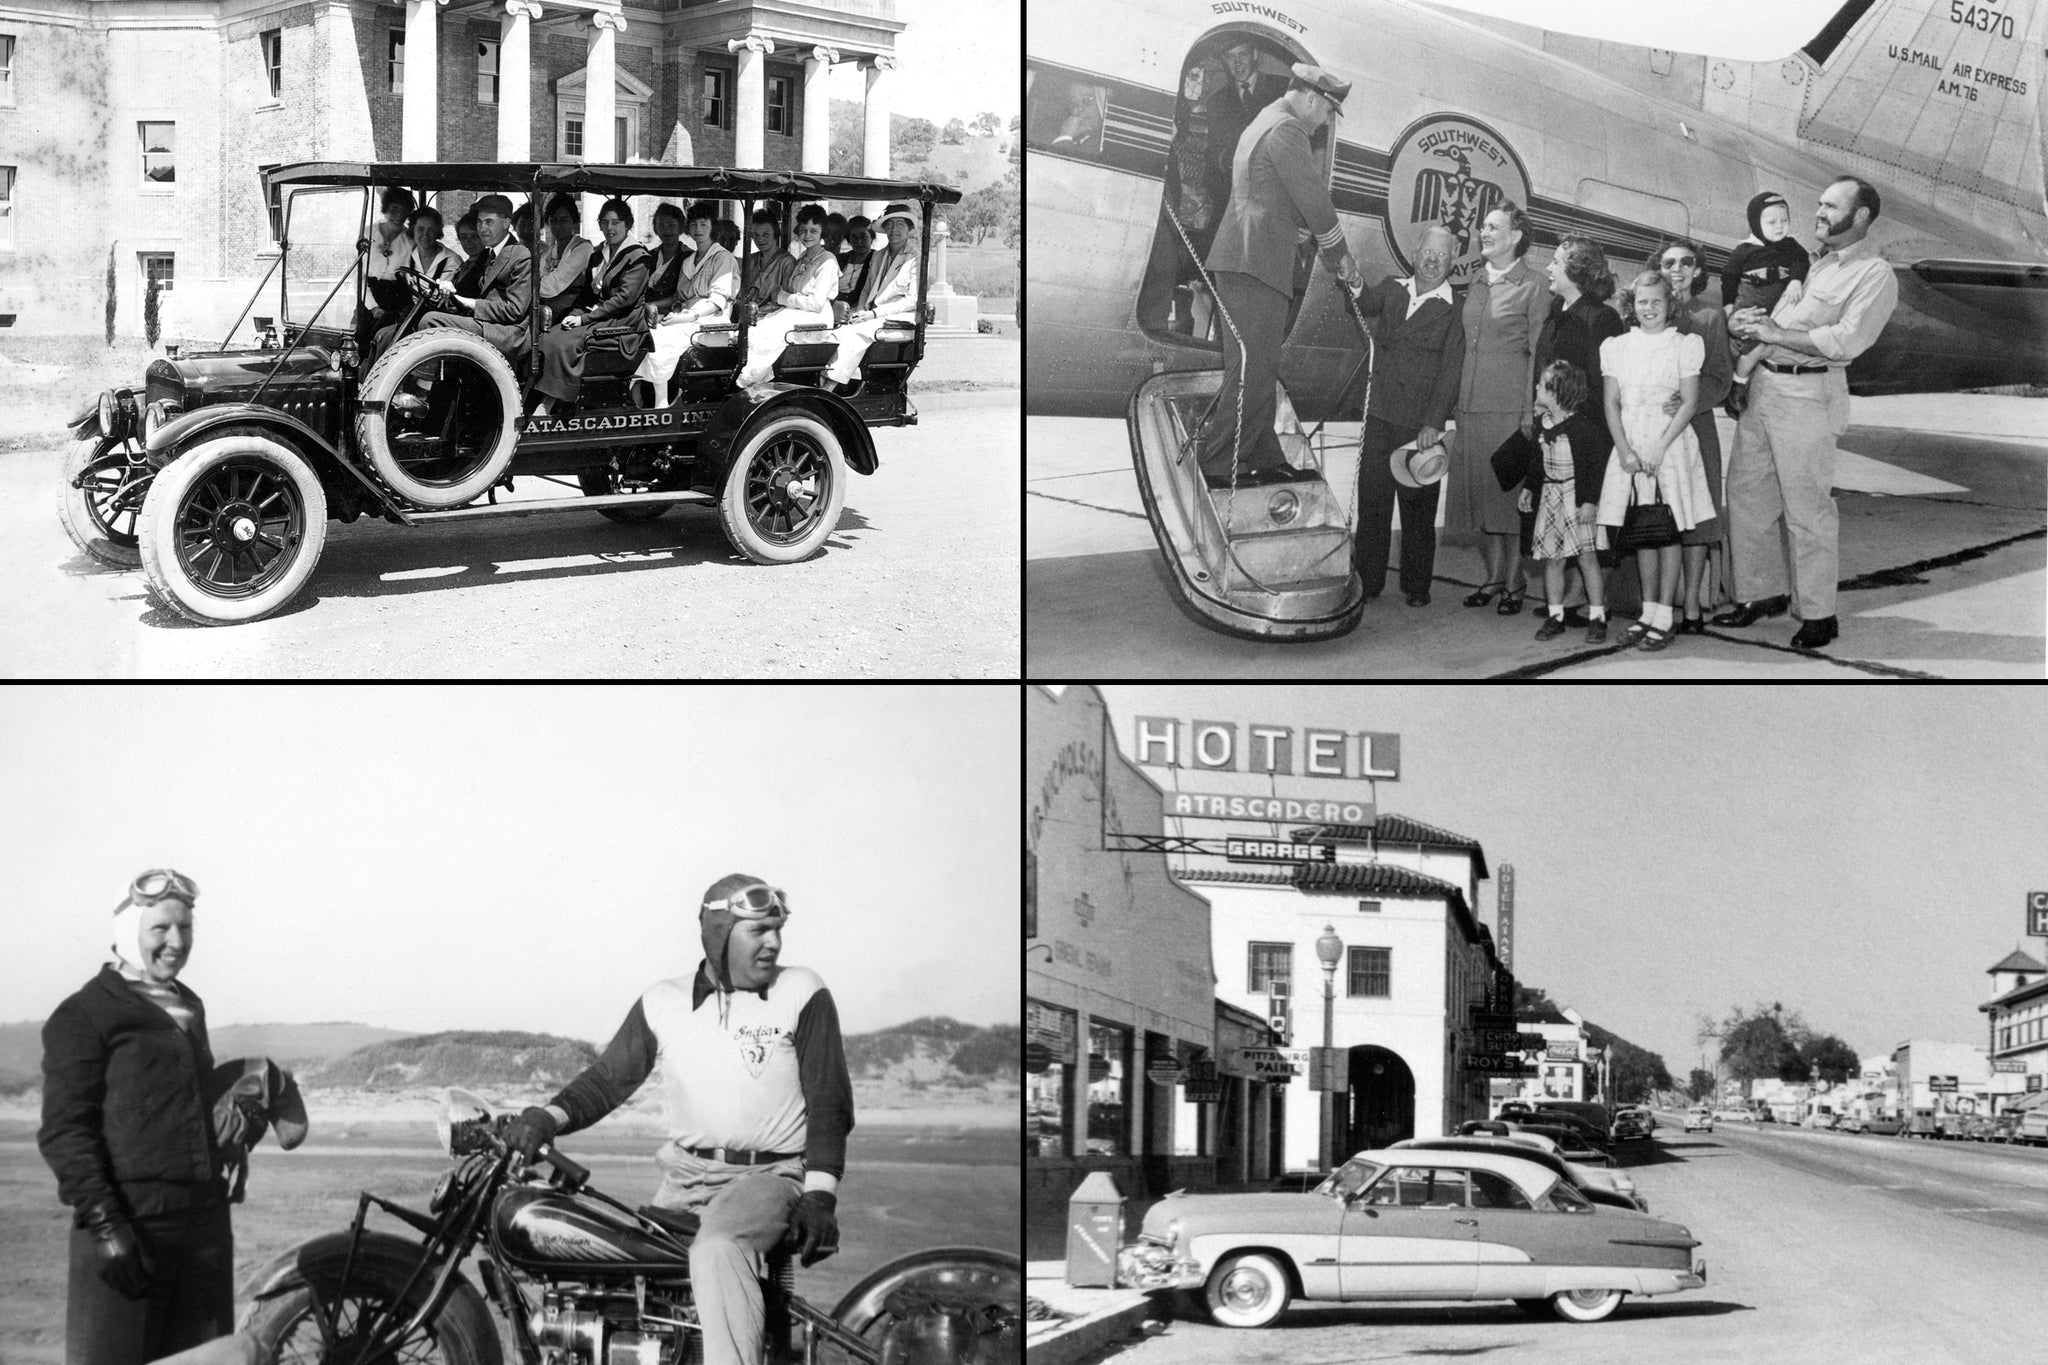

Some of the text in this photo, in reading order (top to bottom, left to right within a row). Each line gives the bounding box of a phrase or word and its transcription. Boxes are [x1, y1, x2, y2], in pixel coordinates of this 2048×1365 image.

[1211, 2, 1308, 34] SOUTHWEST
[1950, 0, 2015, 39] 54370
[1952, 62, 1972, 79] AIR
[1974, 67, 2028, 95] EXPRESS
[1417, 129, 1508, 168] SOUTHWEST
[1138, 720, 1396, 777] HOTEL
[1176, 795, 1363, 822] ATASCADERO
[1228, 840, 1326, 860] GARAGE
[1243, 1051, 1309, 1061] PITTSBURG
[1255, 1062, 1305, 1074] PAINTS
